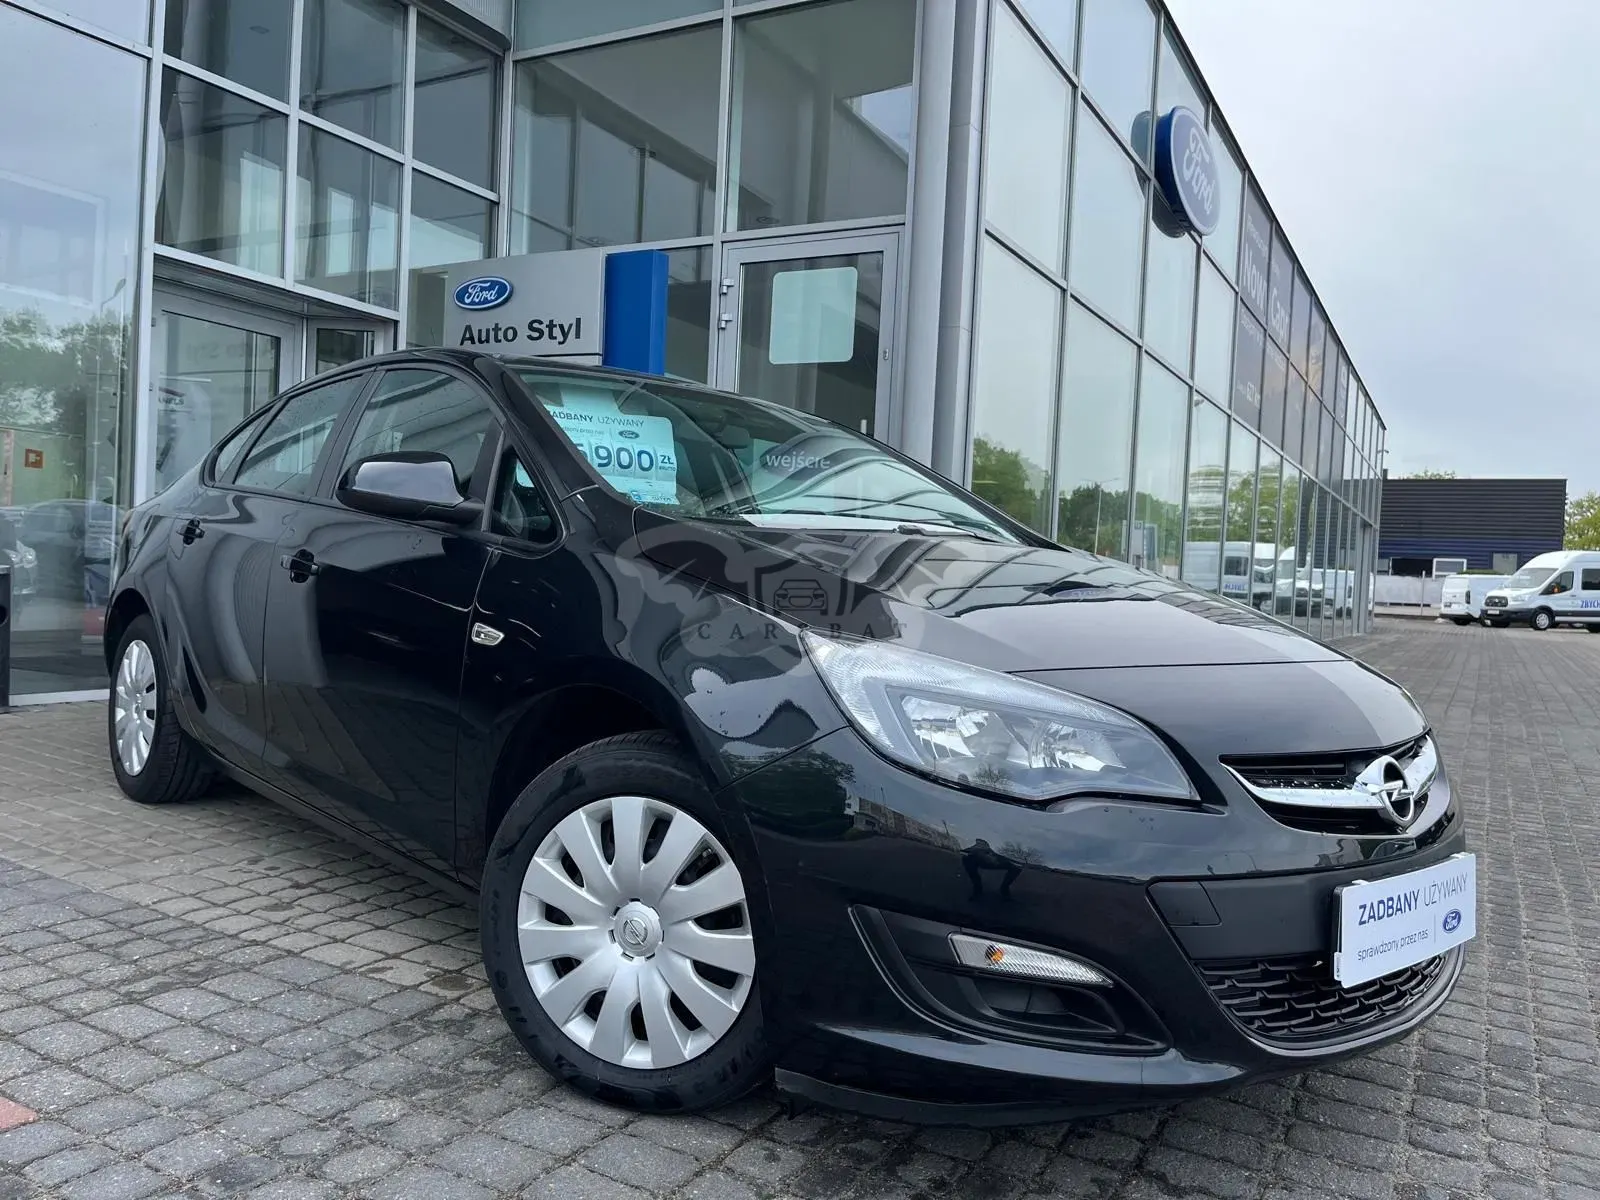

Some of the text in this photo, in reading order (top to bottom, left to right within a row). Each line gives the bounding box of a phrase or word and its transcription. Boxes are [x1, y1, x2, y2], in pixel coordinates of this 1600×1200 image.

[460, 318, 582, 346] Auto Styl
[551, 410, 593, 423] ADBANY
[1358, 872, 1468, 927] ZADBANY UŻYWANY
[1358, 929, 1429, 961] sprawdzony przez nas
